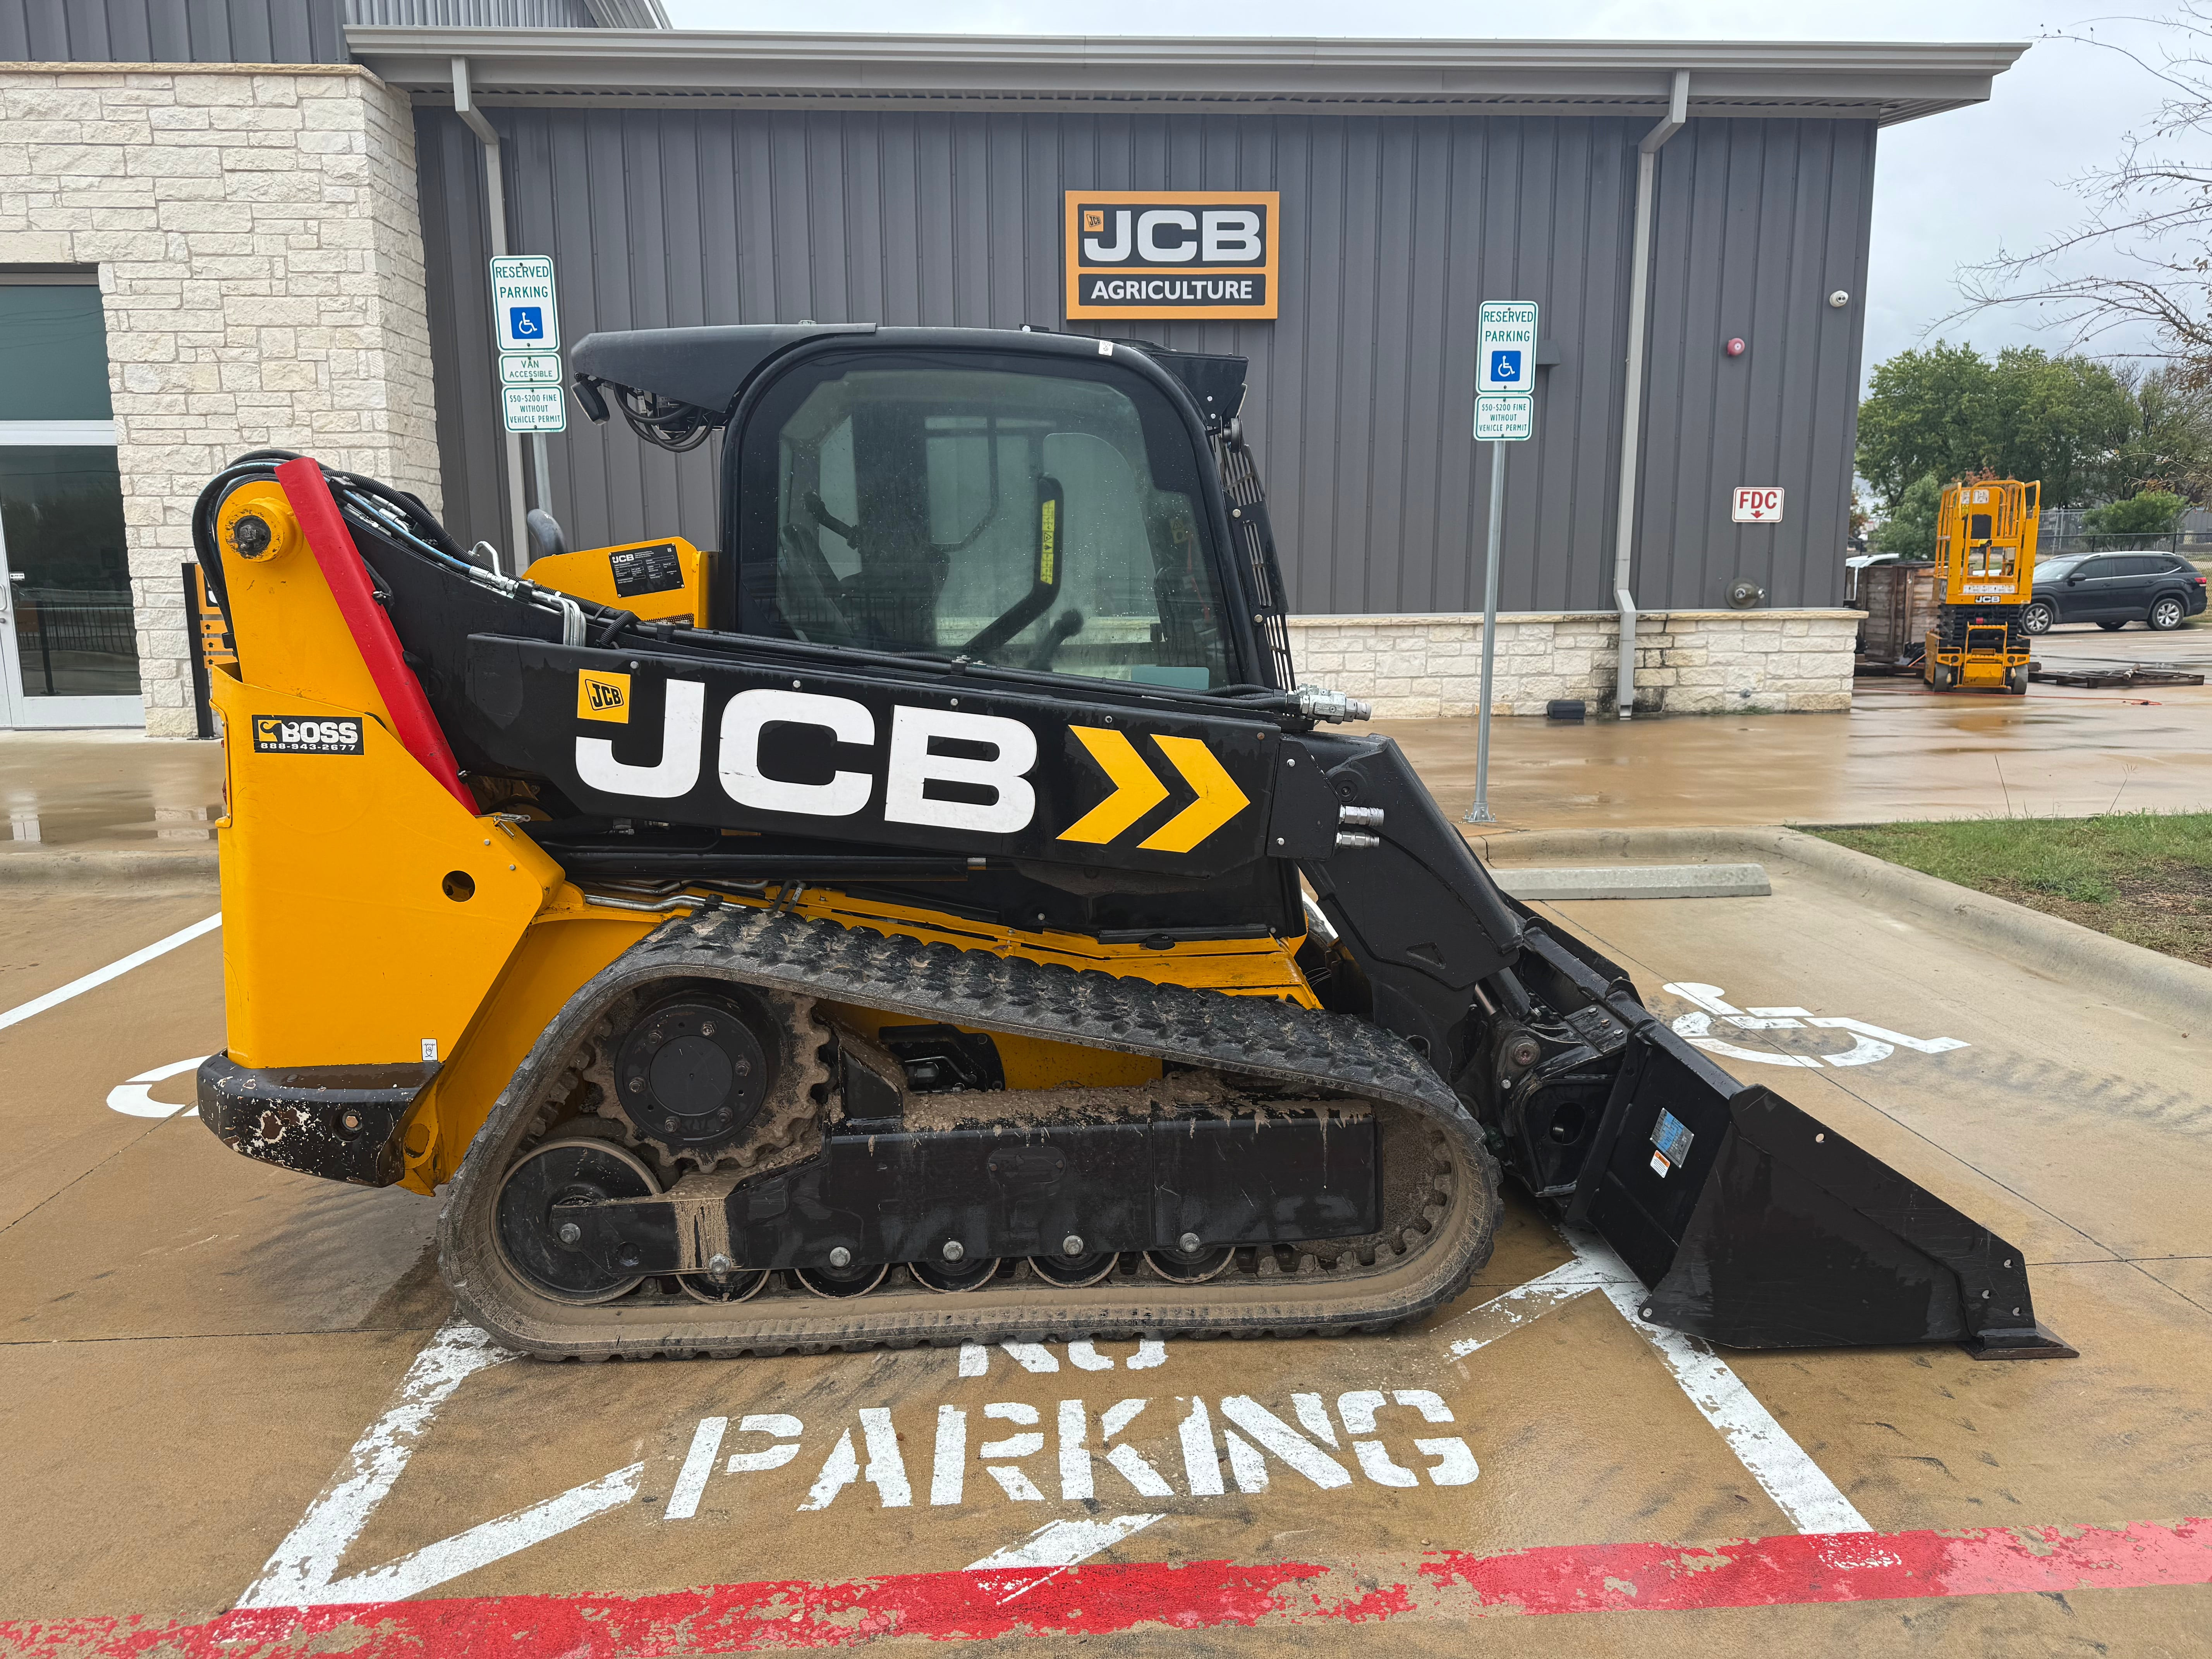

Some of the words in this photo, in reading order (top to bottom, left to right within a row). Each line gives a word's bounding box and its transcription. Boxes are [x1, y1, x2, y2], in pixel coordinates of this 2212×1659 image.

[1089, 216, 1100, 225] JCB
[1084, 210, 1261, 261] JCB
[495, 266, 549, 278] RESERVED
[500, 286, 548, 298] PARKING
[1091, 281, 1252, 299] AGRICULTURE
[1484, 311, 1534, 323] RESERVED
[1485, 330, 1530, 342] PARKING
[521, 360, 539, 368] VAN
[509, 394, 540, 403] $50-$200
[1739, 491, 1778, 509] FDC
[612, 553, 634, 563] JCB
[592, 683, 621, 707] JCB
[281, 722, 358, 744] BOSS
[260, 743, 356, 751] 888-943-2677
[575, 678, 1037, 834] JCB
[663, 1389, 1480, 1520] PARKING
